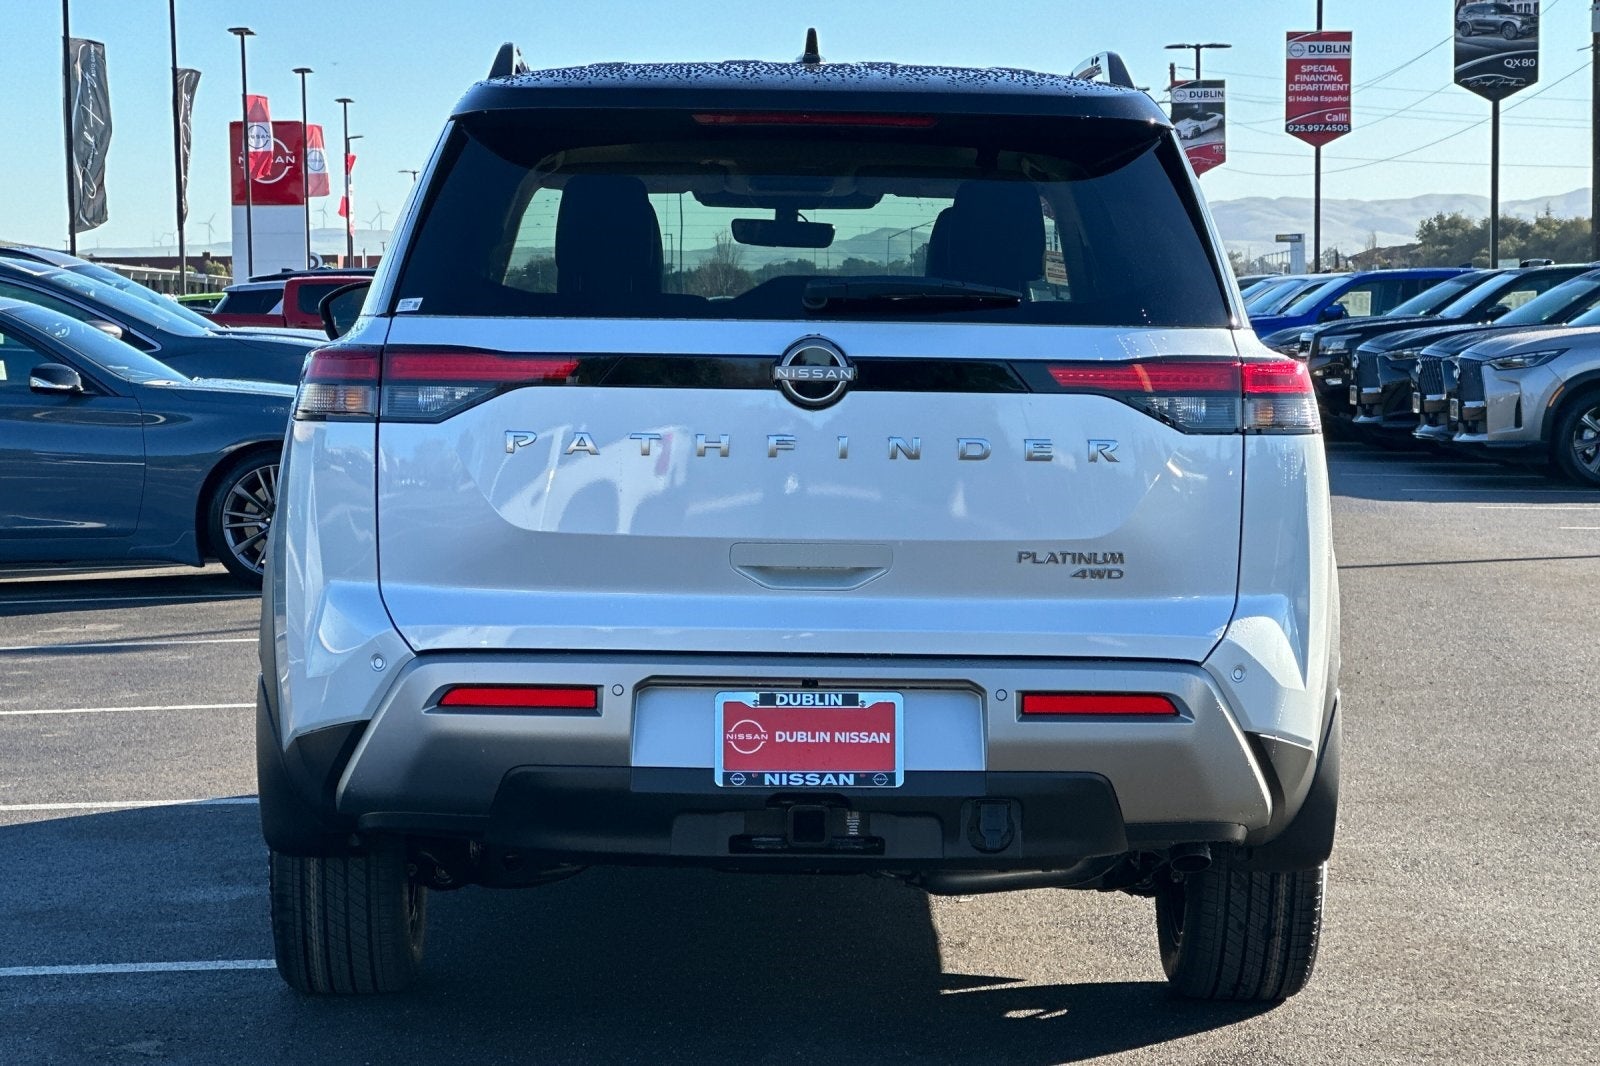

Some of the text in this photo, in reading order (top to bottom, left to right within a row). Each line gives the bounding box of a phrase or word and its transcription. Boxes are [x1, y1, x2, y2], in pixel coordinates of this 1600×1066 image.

[1308, 44, 1351, 54] DUBLIN
[1503, 58, 1536, 69] QX80
[1300, 65, 1338, 73] SPECIAL
[1294, 74, 1343, 82] FINANCING
[1288, 83, 1349, 91] DEPARTMENT
[1189, 90, 1224, 99] DUBLIN
[1319, 95, 1349, 103] Español
[1325, 113, 1348, 121] Call!
[1288, 124, 1349, 132] 925.997.4505
[776, 368, 852, 379] NISSAN
[504, 429, 1120, 462] PATHFINDER
[1017, 551, 1125, 565] PLATINUM
[1070, 568, 1124, 579] 4WD
[775, 693, 843, 706] DUBLIN
[726, 733, 769, 741] NISSAN
[775, 731, 891, 744] DUBLIN NISSAN
[764, 773, 855, 786] NISSAN
